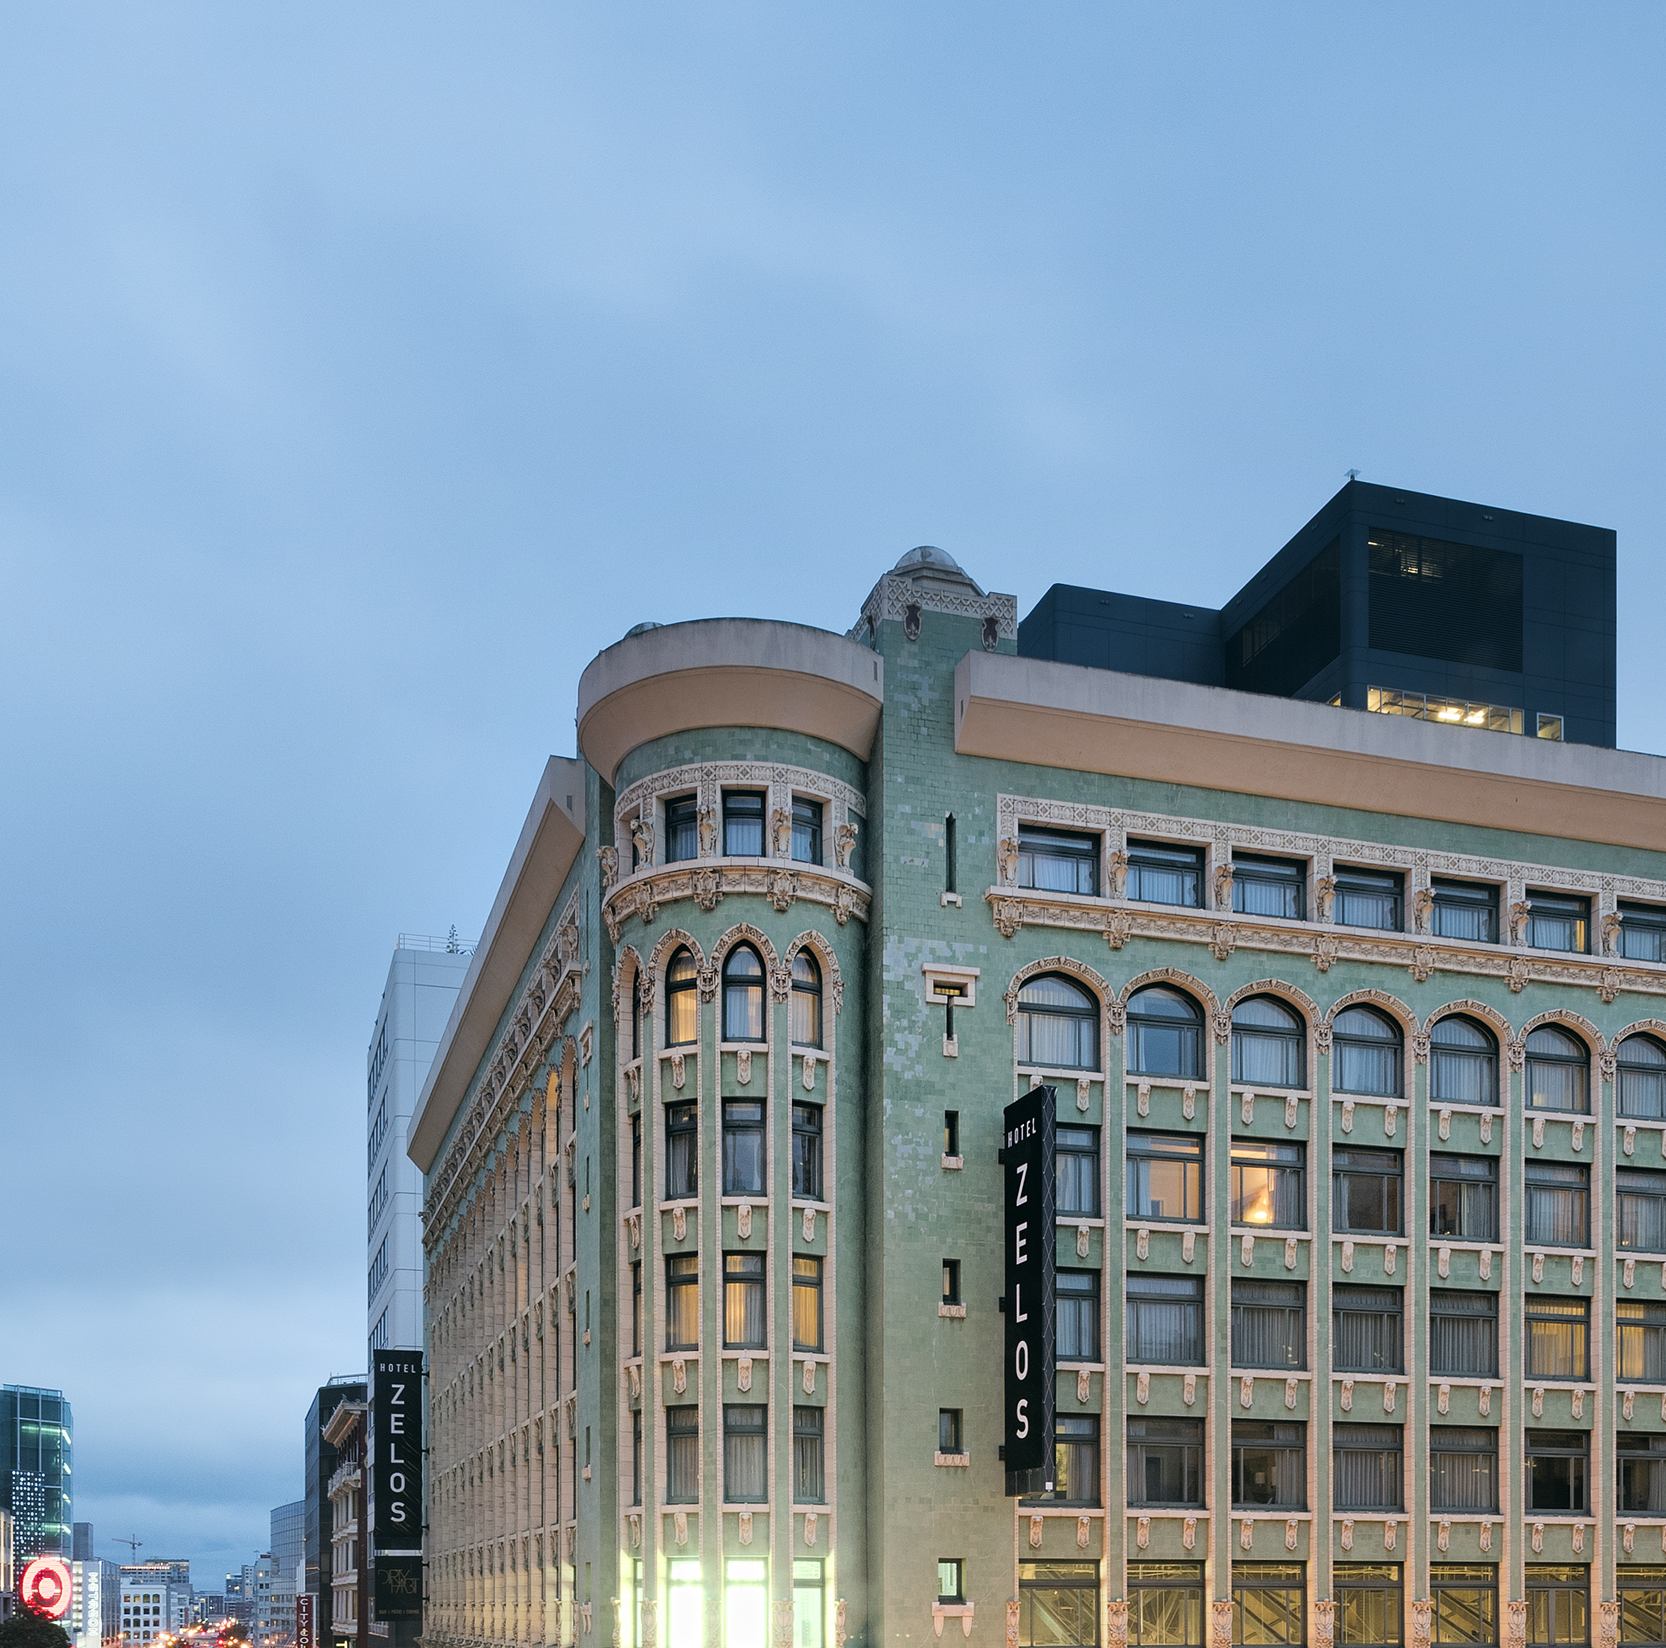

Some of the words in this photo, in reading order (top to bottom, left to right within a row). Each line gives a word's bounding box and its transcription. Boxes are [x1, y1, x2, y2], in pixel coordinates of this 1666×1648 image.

[1007, 1117, 1037, 1148] HOTEL
[1016, 1162, 1029, 1440] ZELOS
[380, 1363, 416, 1373] HOTEL
[390, 1384, 406, 1523] ZELOS
[88, 1571, 99, 1637] METREON
[300, 1598, 309, 1627] CITY
